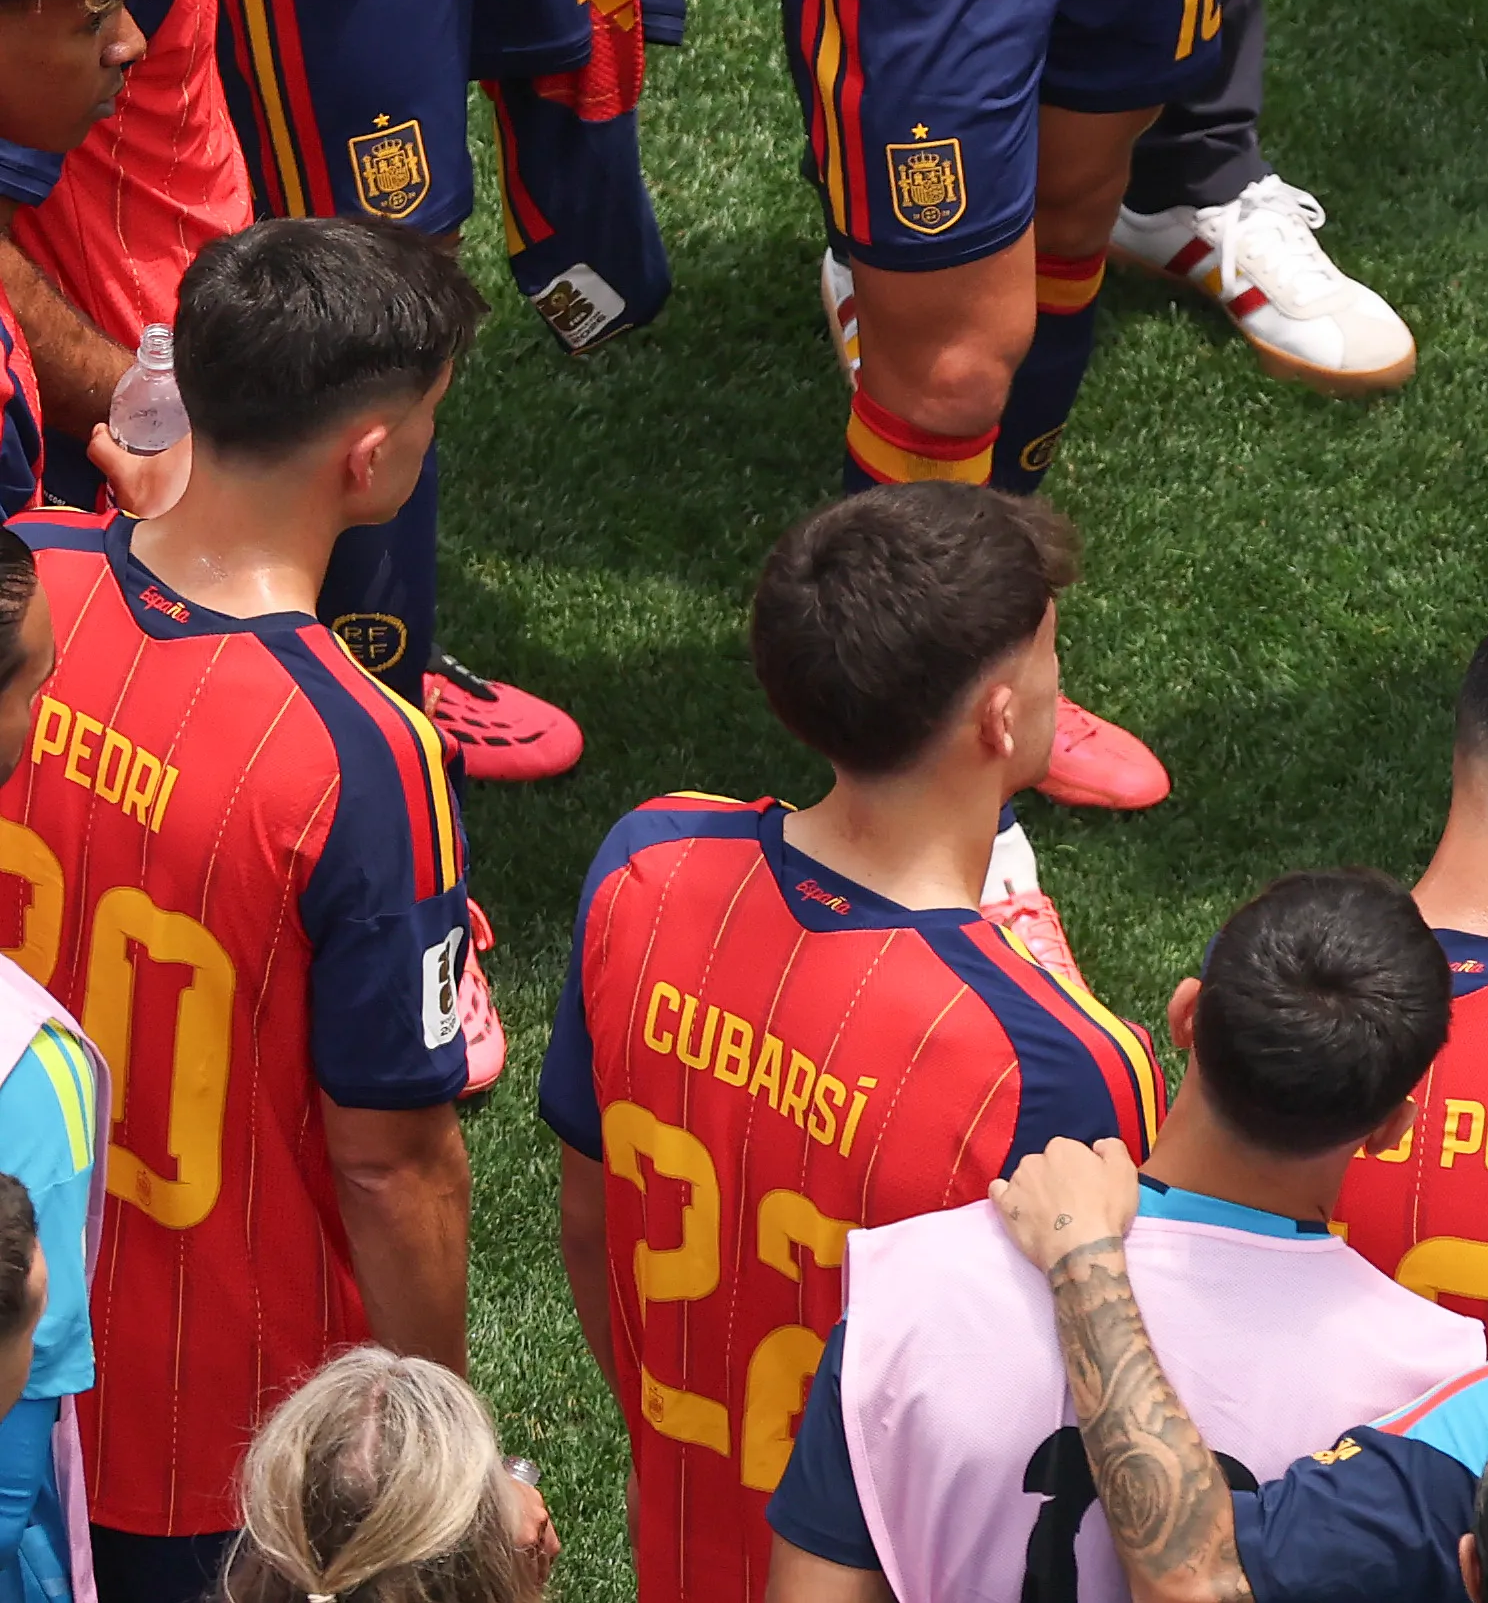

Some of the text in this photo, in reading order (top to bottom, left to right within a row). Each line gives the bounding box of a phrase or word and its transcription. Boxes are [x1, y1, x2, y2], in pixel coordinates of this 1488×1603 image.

[138, 584, 192, 625] España
[31, 695, 180, 834] PEDRI
[794, 877, 852, 917] España
[642, 980, 880, 1158] CUBARSÍ
